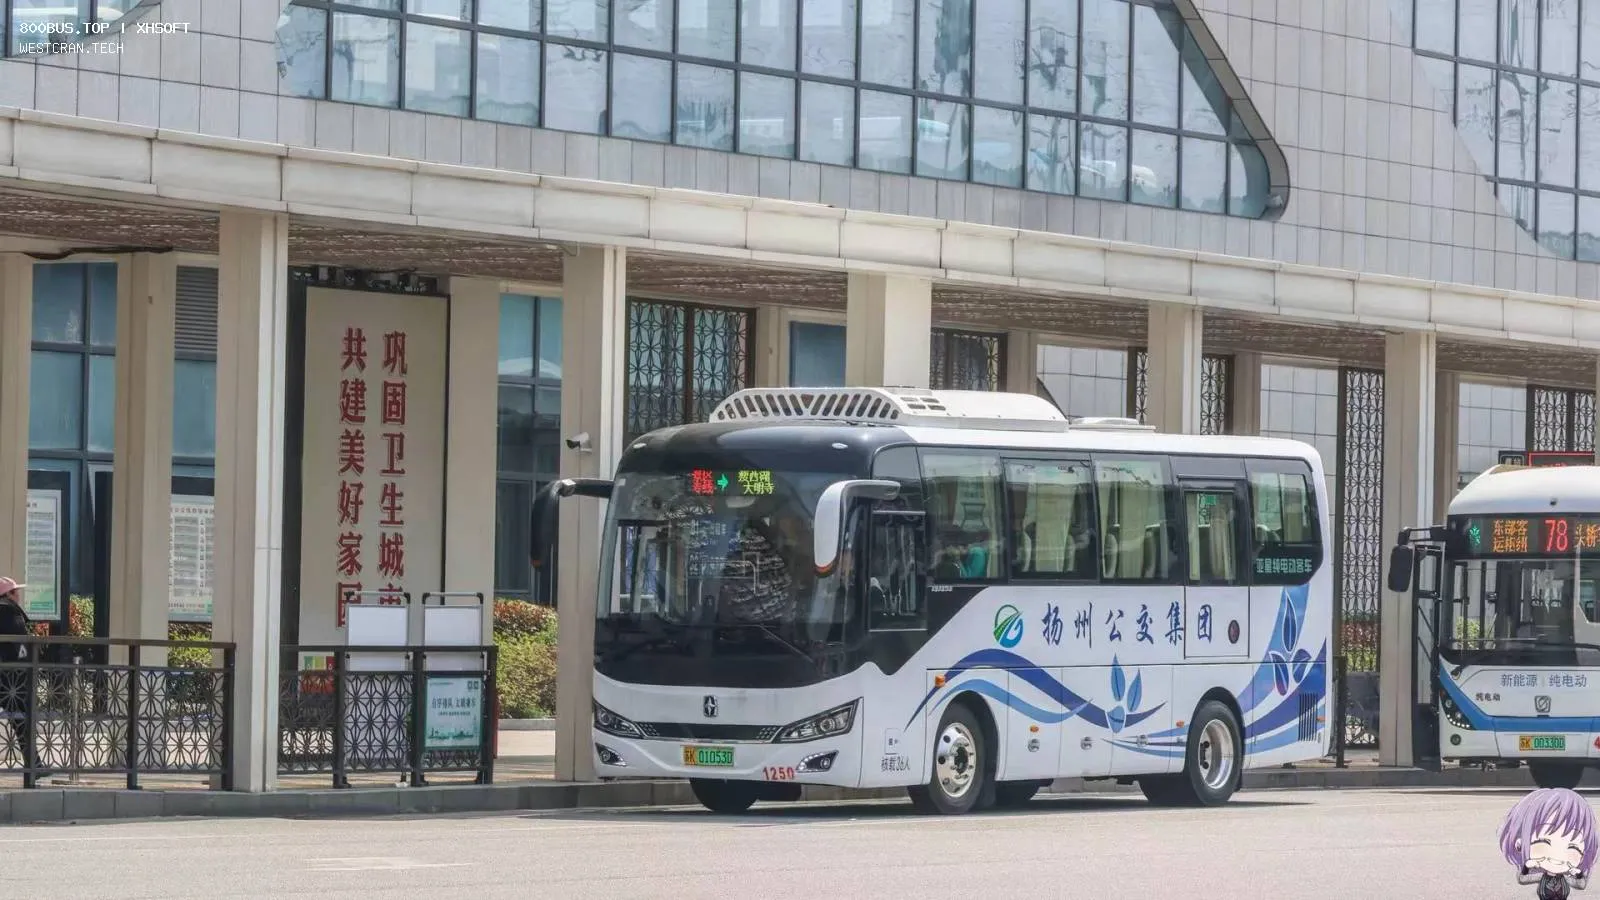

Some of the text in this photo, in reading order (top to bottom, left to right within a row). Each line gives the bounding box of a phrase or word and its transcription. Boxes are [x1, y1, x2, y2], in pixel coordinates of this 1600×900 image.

[743, 482, 775, 495] 大明寺
[1545, 519, 1569, 552] 78
[1041, 601, 1213, 648] 扬州公交集团
[1501, 674, 1588, 687] 新能源 纯电动
[763, 766, 795, 780] 1250
